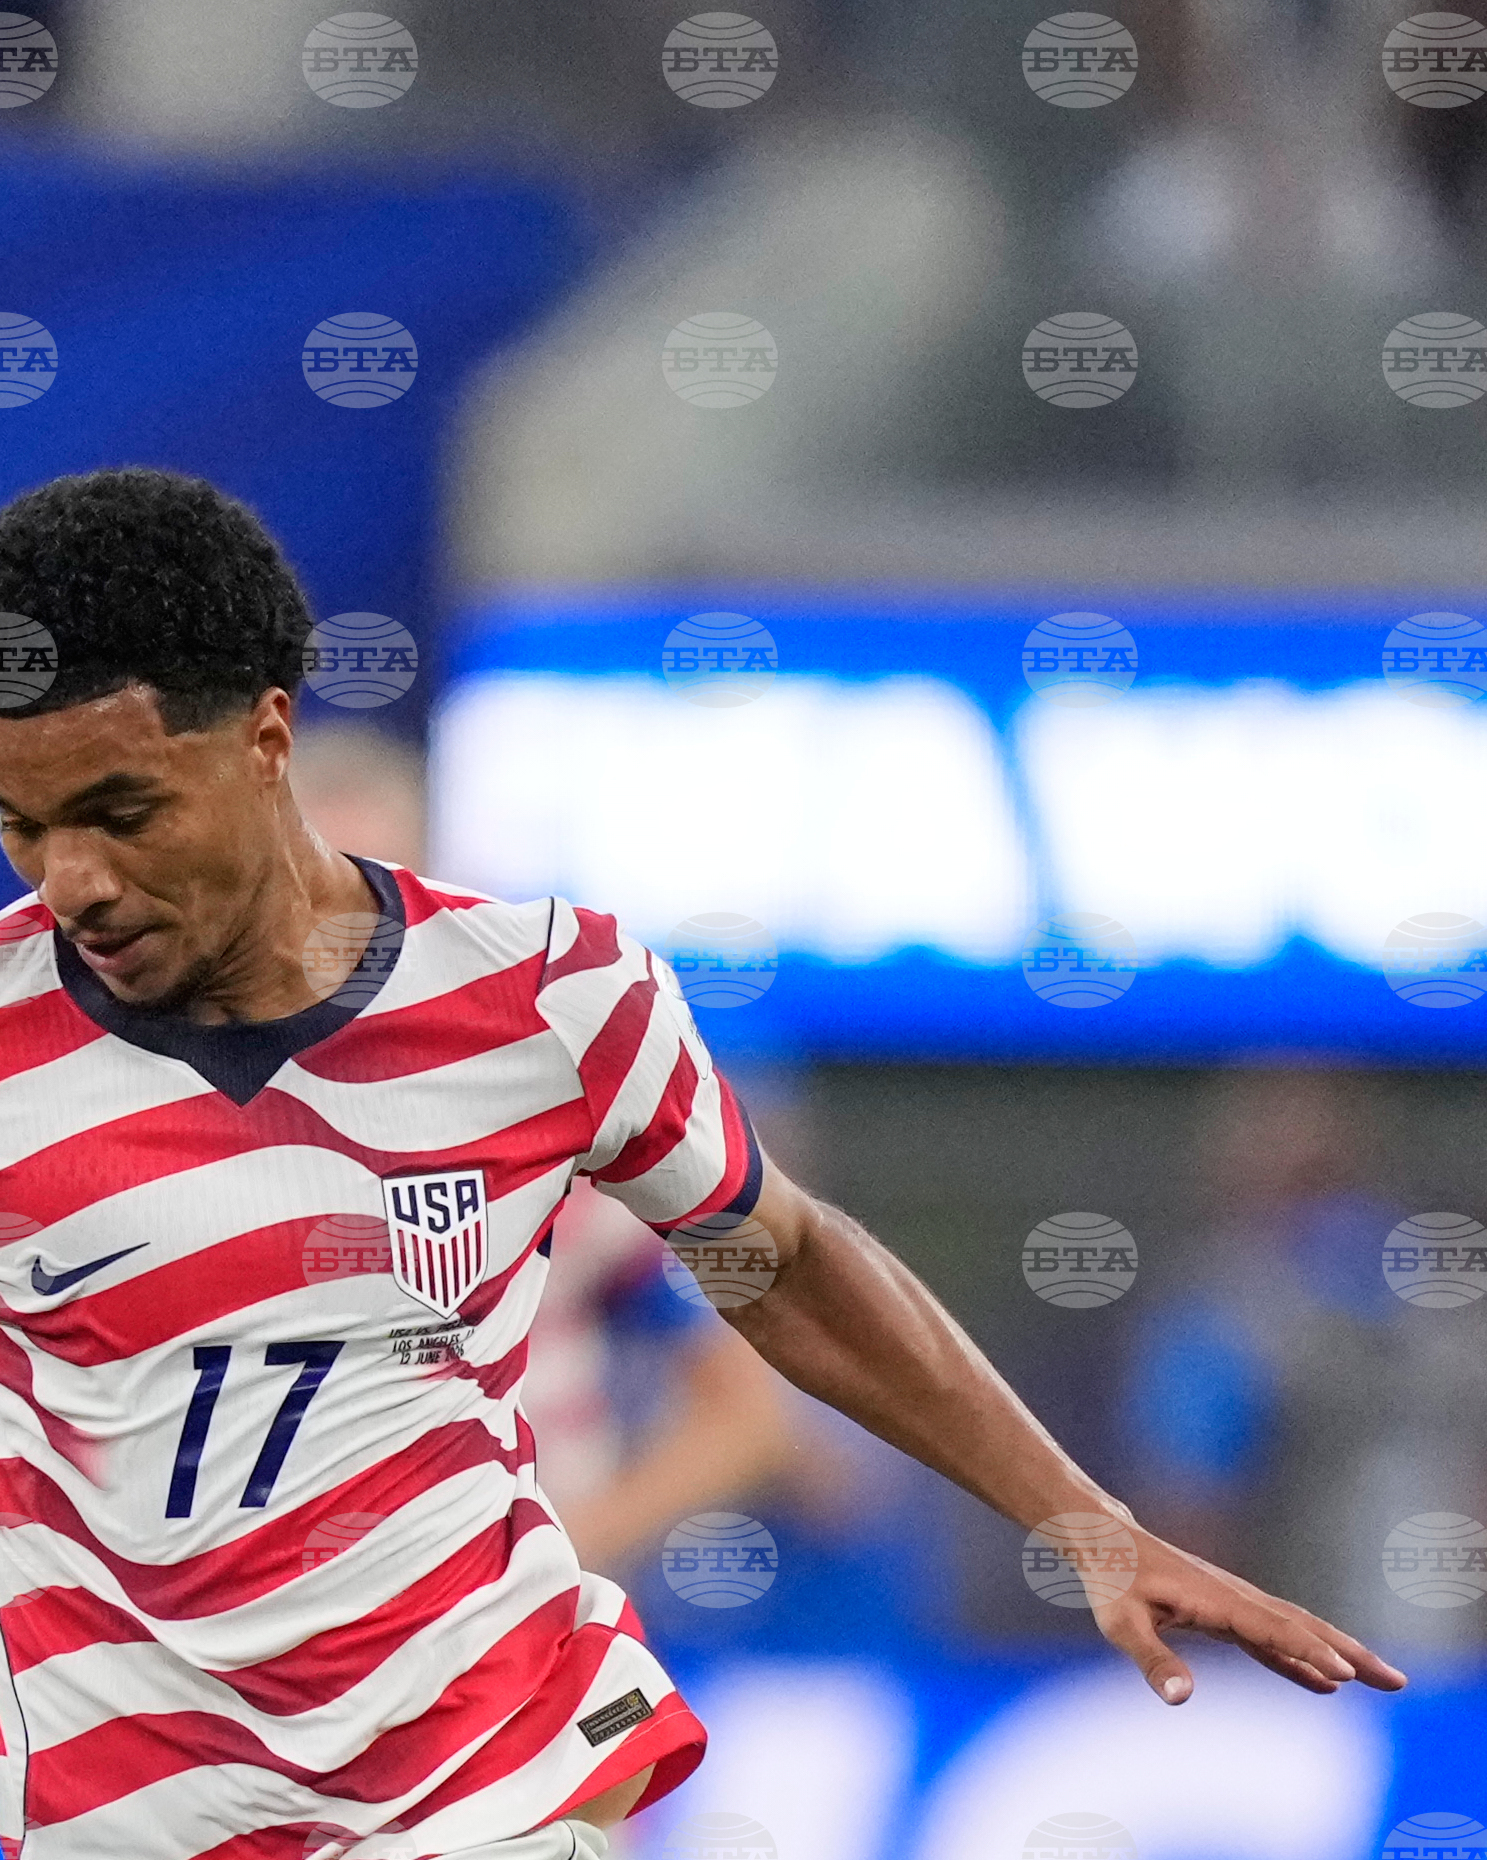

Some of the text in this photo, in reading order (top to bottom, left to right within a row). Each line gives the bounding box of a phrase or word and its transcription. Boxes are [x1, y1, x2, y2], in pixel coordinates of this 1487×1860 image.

[392, 1178, 481, 1235] USA
[392, 1339, 413, 1353] LOS
[414, 1350, 442, 1365] JUNE
[165, 1340, 348, 1519] 17
